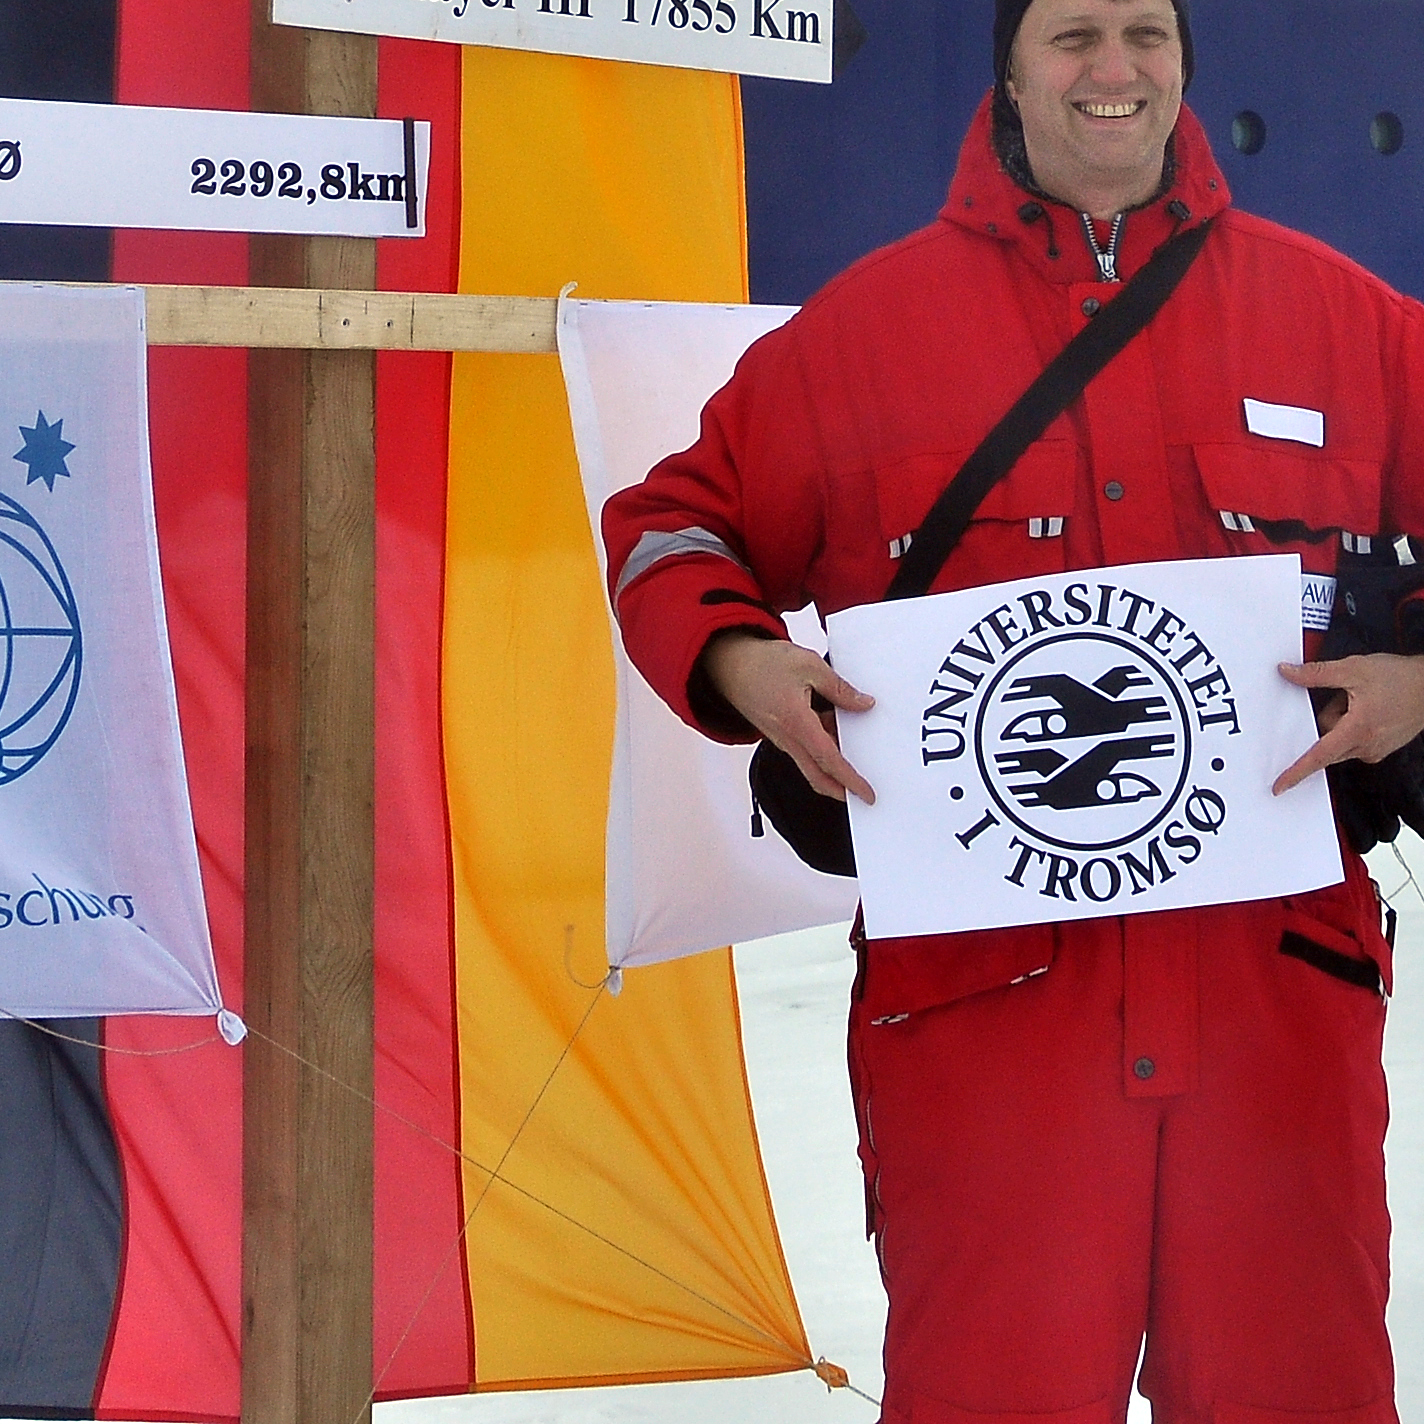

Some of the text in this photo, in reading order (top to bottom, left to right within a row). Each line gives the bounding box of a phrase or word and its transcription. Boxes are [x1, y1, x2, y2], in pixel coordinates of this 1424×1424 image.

[191, 158, 418, 206] 2292,8km
[1301, 582, 1334, 605] AWI
[921, 582, 1241, 766] UNIVERSITETET
[955, 784, 1227, 903] I TROMSØ
